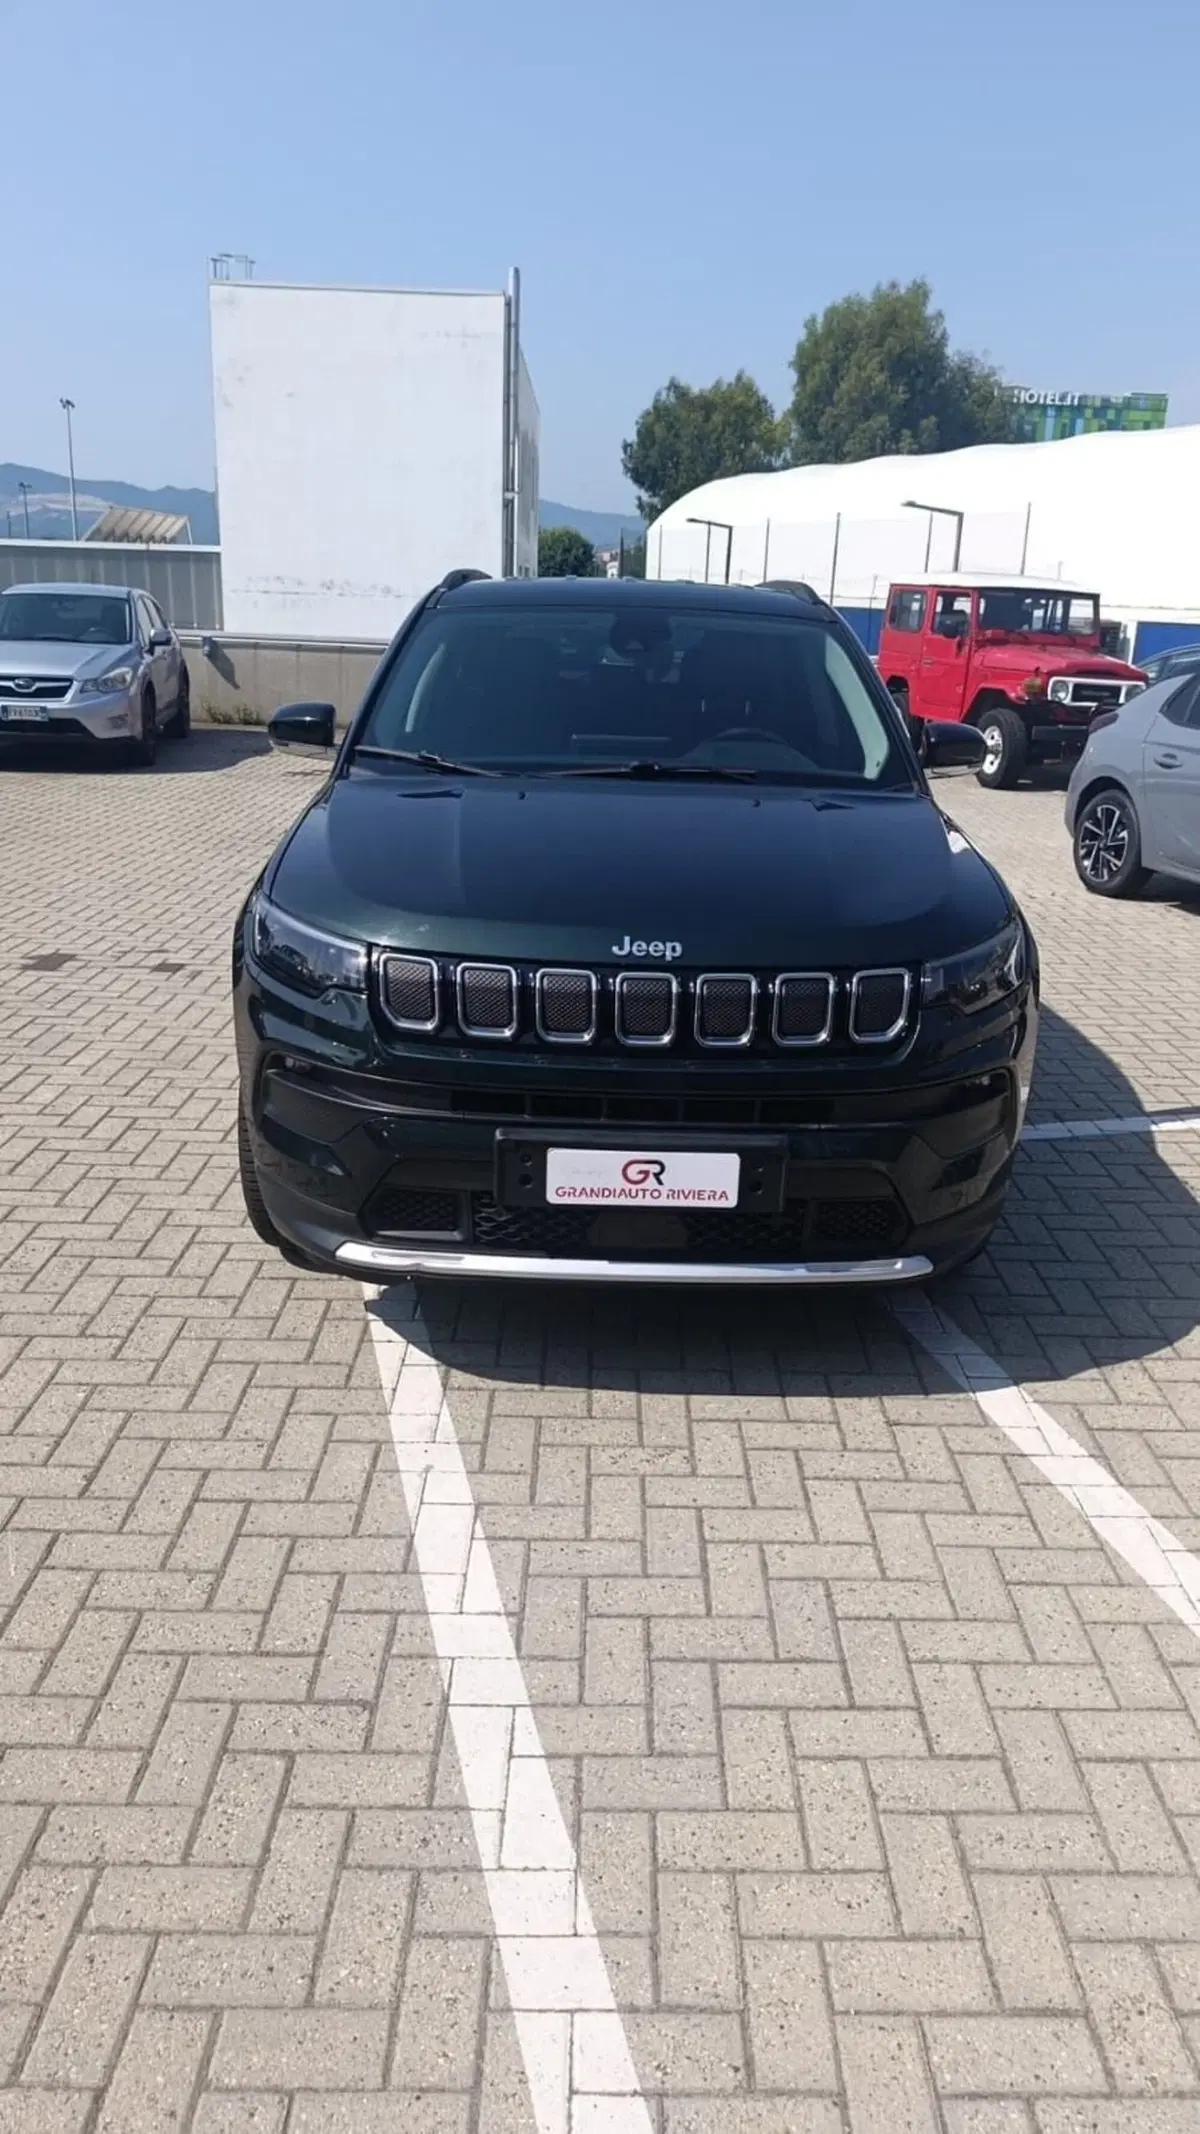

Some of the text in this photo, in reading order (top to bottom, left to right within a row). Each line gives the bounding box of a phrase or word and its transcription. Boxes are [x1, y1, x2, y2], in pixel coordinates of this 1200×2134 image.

[611, 935, 683, 961] Jeep
[621, 1159, 666, 1185] GR
[555, 1186, 729, 1201] GRANDIAUTO RIVIERA
